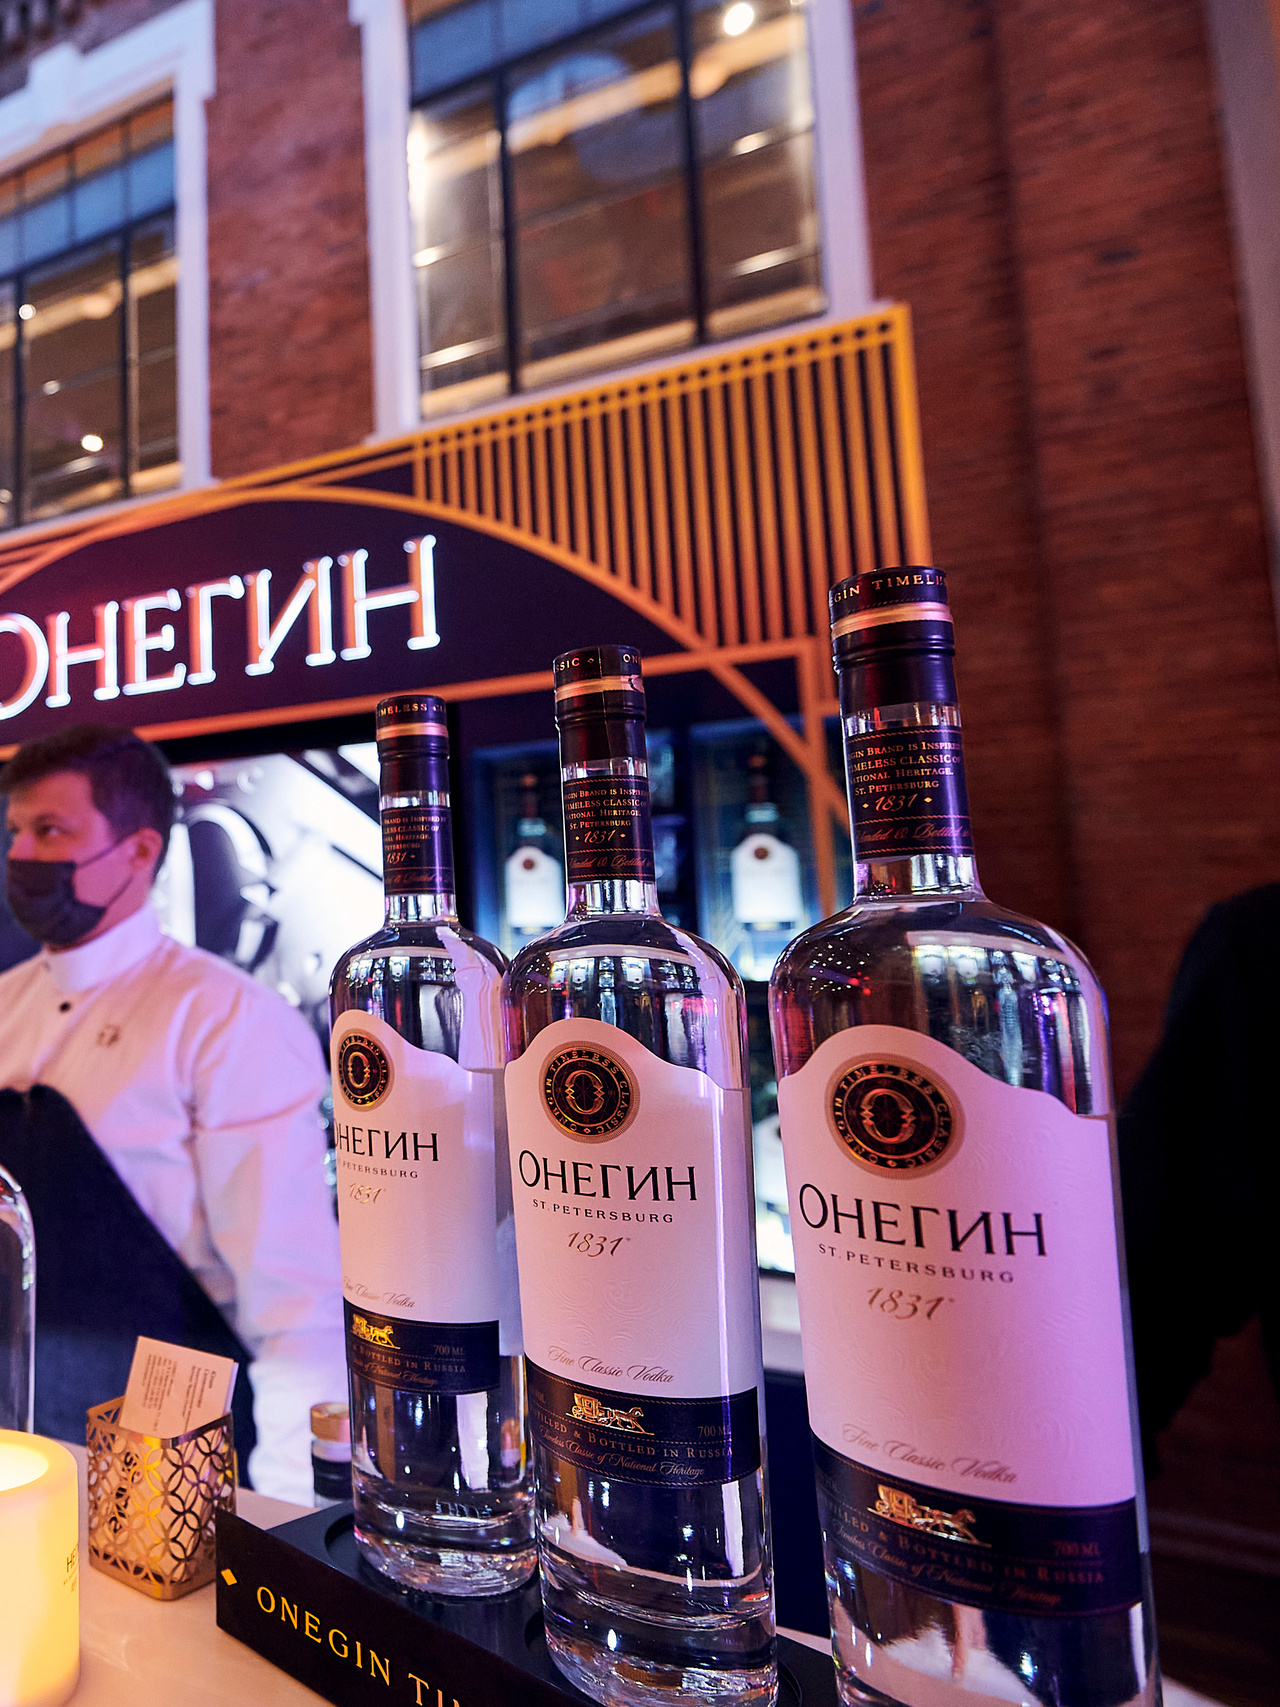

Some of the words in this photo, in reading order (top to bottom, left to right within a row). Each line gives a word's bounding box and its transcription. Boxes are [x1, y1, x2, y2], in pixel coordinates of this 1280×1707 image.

[899, 754, 952, 766] CLASSIC
[579, 790, 607, 798] BRAND
[868, 780, 940, 794] PETERSBURG
[602, 798, 640, 807] CLASSIC
[874, 793, 918, 812] 1831
[579, 819, 631, 829] PETERSBURG
[583, 829, 616, 845] 1831
[386, 851, 407, 865] 1831
[518, 1149, 698, 1202] ОНЕГИН
[349, 1182, 384, 1205] 1831
[798, 1183, 1048, 1257] ОНЕГИН
[567, 1231, 624, 1258] 1831
[382, 1291, 416, 1308] Vodka
[866, 1286, 946, 1321] 1831
[548, 1345, 575, 1367] Fine
[577, 1355, 624, 1378] Classic
[626, 1364, 675, 1384] Vodka
[697, 1425, 717, 1439] 700
[588, 1431, 656, 1456] BOTTLED
[608, 1453, 658, 1472] National
[659, 1461, 705, 1480] Heritage
[882, 1439, 946, 1472] Classic
[949, 1456, 1019, 1485] Vodka
[256, 1585, 391, 1687] ONEGIN
